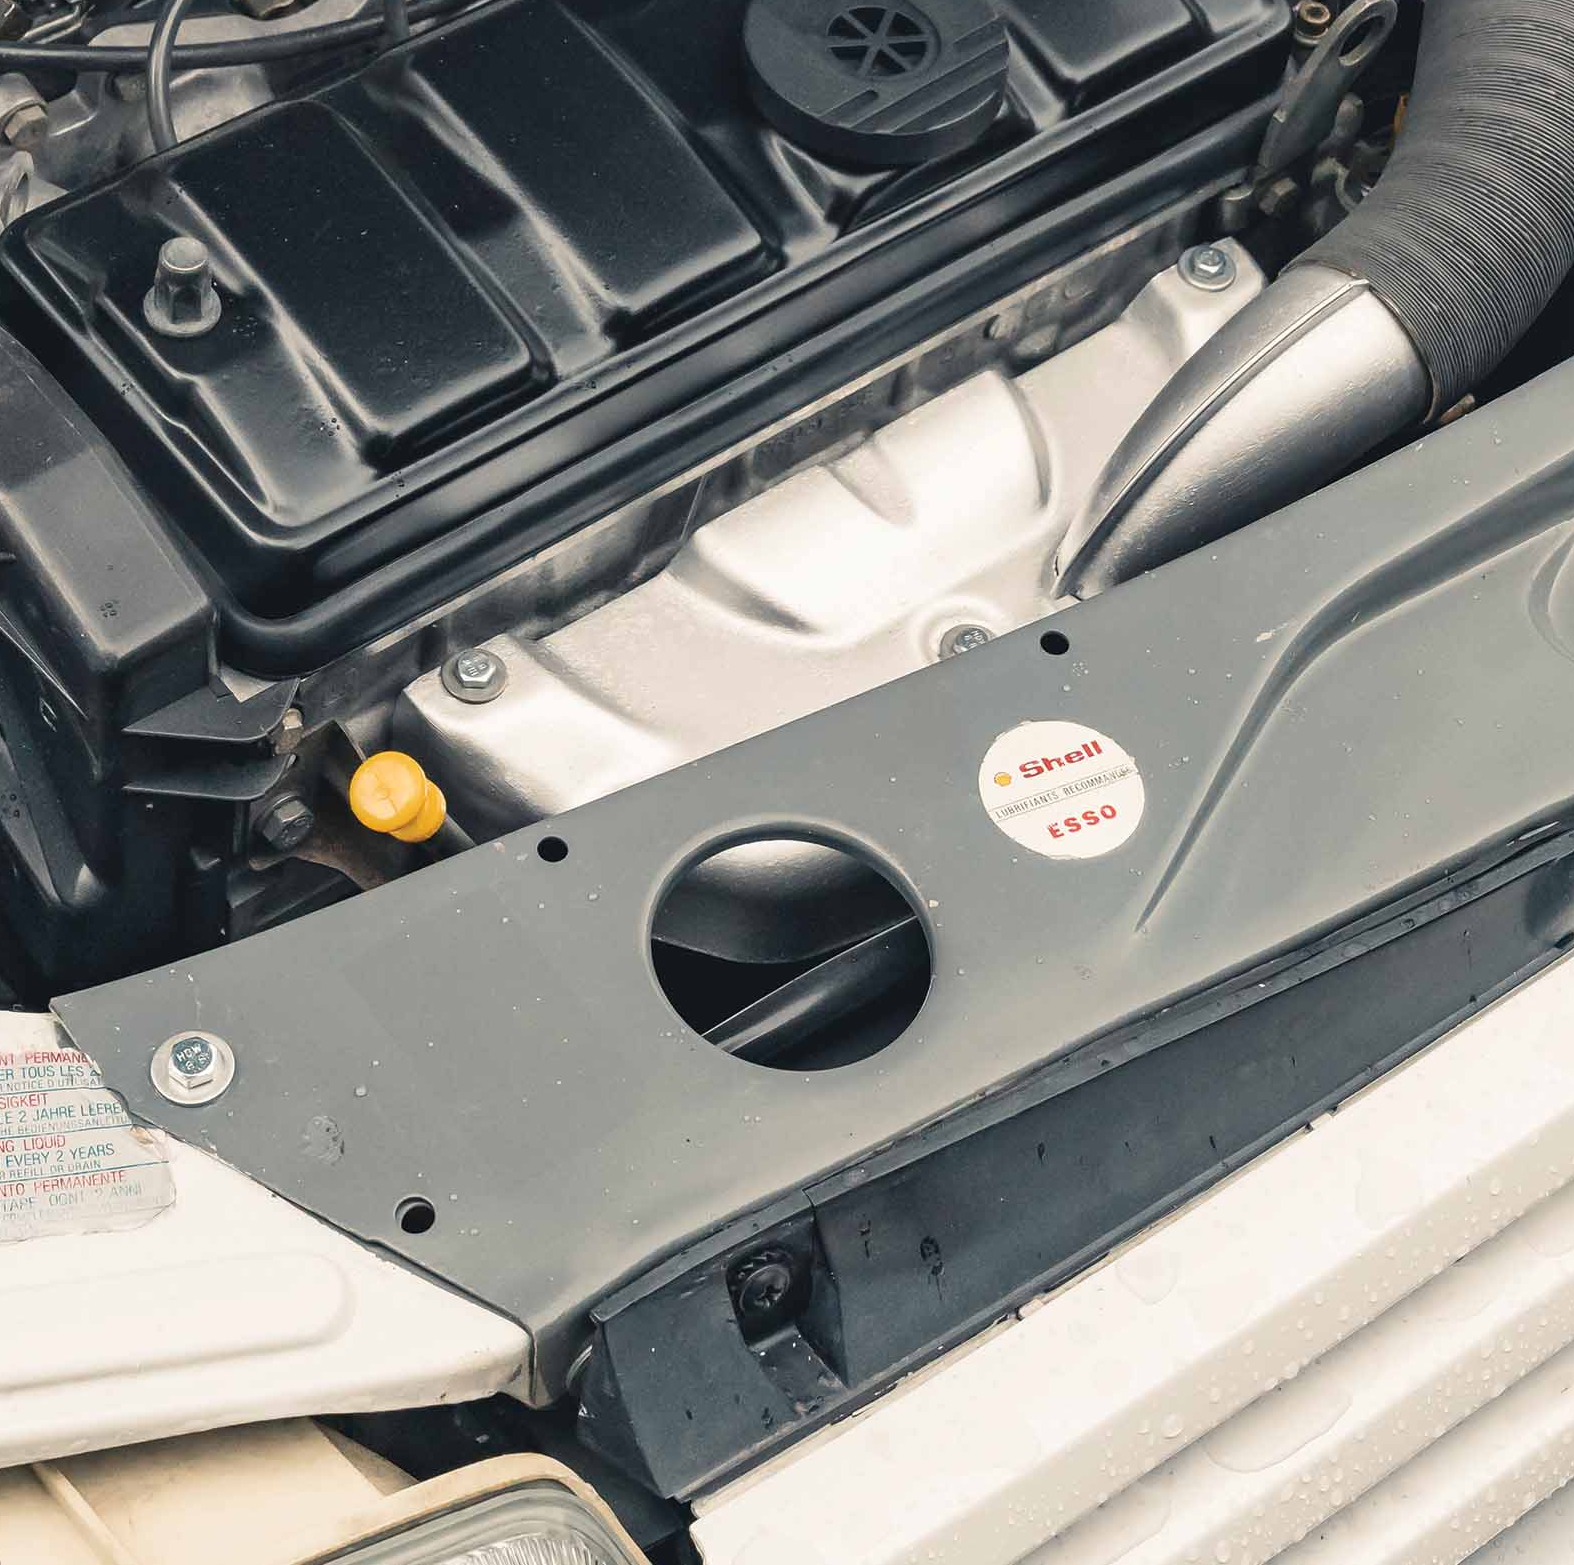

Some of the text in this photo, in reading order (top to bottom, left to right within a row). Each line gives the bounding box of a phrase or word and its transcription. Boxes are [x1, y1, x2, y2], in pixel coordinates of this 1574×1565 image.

[1018, 739, 1104, 779] Shell
[995, 790, 1060, 819] LUBRIFIANTS
[1047, 804, 1118, 839] ESSO
[21, 1066, 55, 1080] TOUS
[59, 1066, 85, 1078] LES
[6, 1081, 44, 1093] NOTICE
[18, 1111, 27, 1124] 2
[32, 1106, 76, 1123] JAHRE
[24, 1135, 66, 1151] LIQUID
[5, 1151, 50, 1168] EVERY
[56, 1150, 64, 1163] 2
[69, 1143, 115, 1160] YEARS
[9, 1166, 44, 1180] REFILL
[50, 1164, 65, 1175] OR
[67, 1160, 102, 1173] DRAIN
[33, 1170, 127, 1196] PERMANENTE
